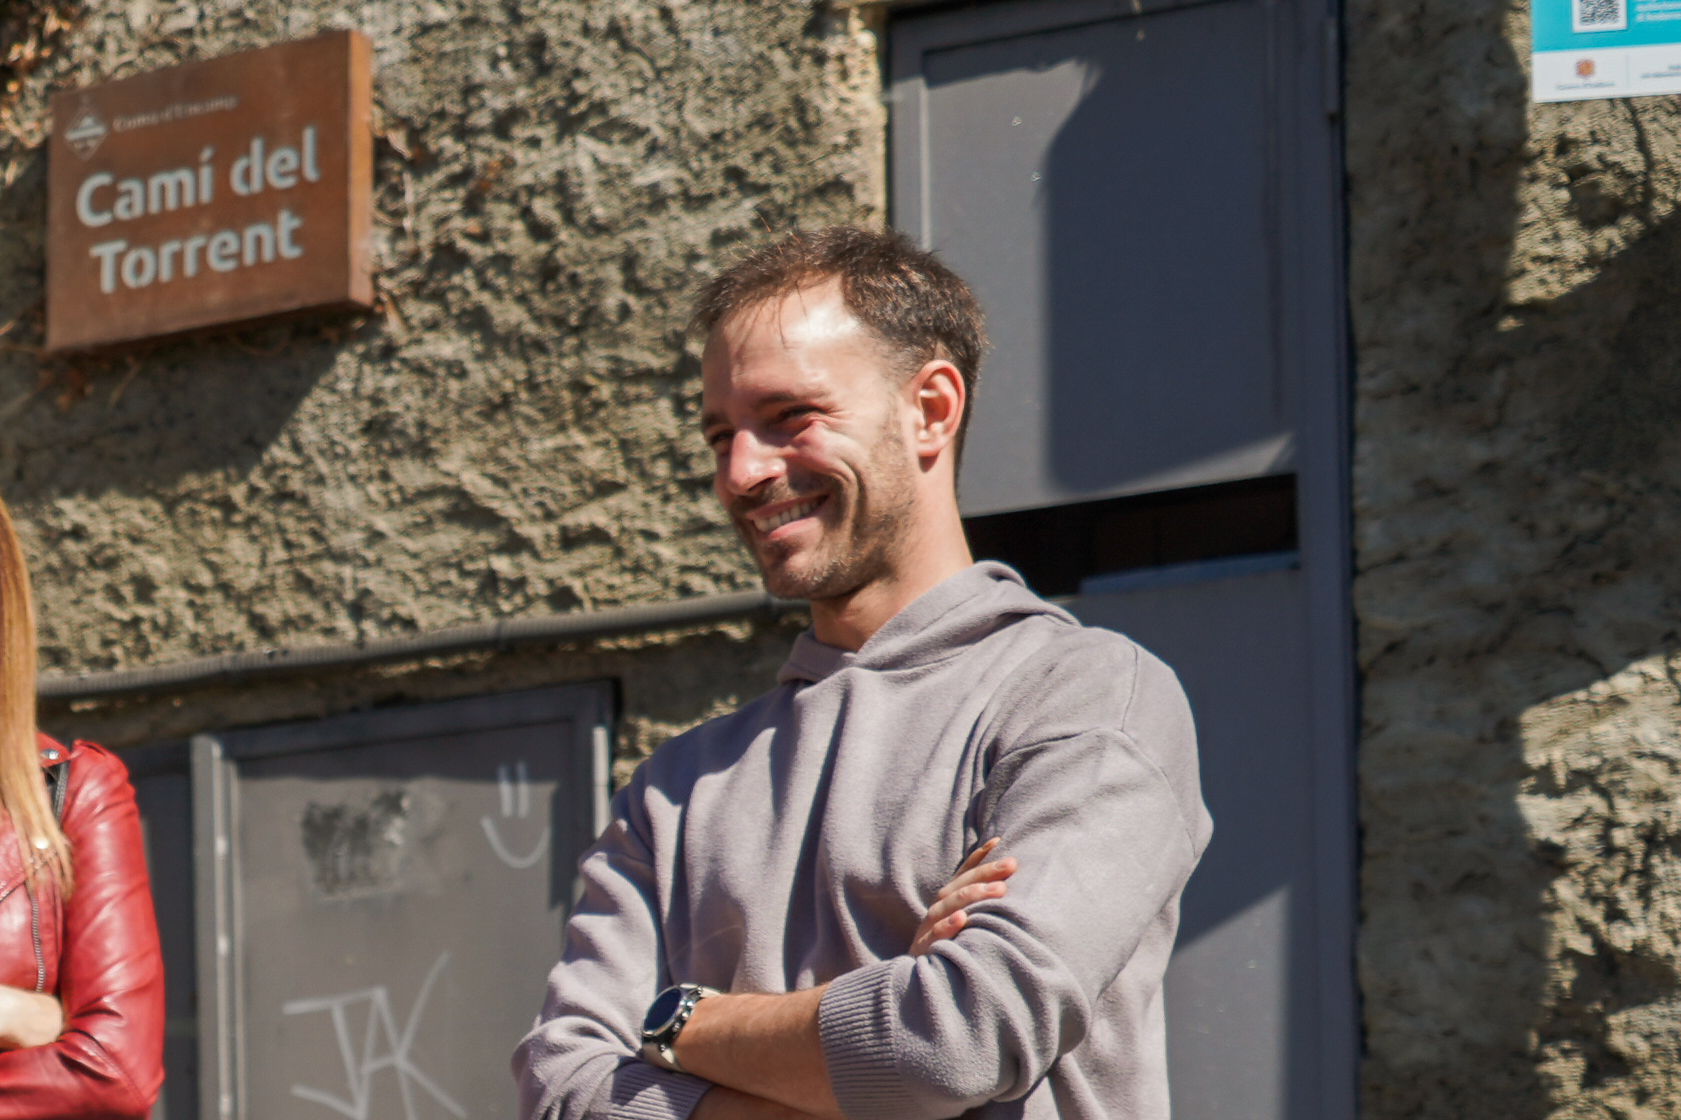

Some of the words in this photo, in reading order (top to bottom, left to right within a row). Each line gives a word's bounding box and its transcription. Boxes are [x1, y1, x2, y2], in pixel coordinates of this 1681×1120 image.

[75, 146, 215, 228] Camí
[229, 124, 320, 197] del
[88, 208, 303, 295] Torrent
